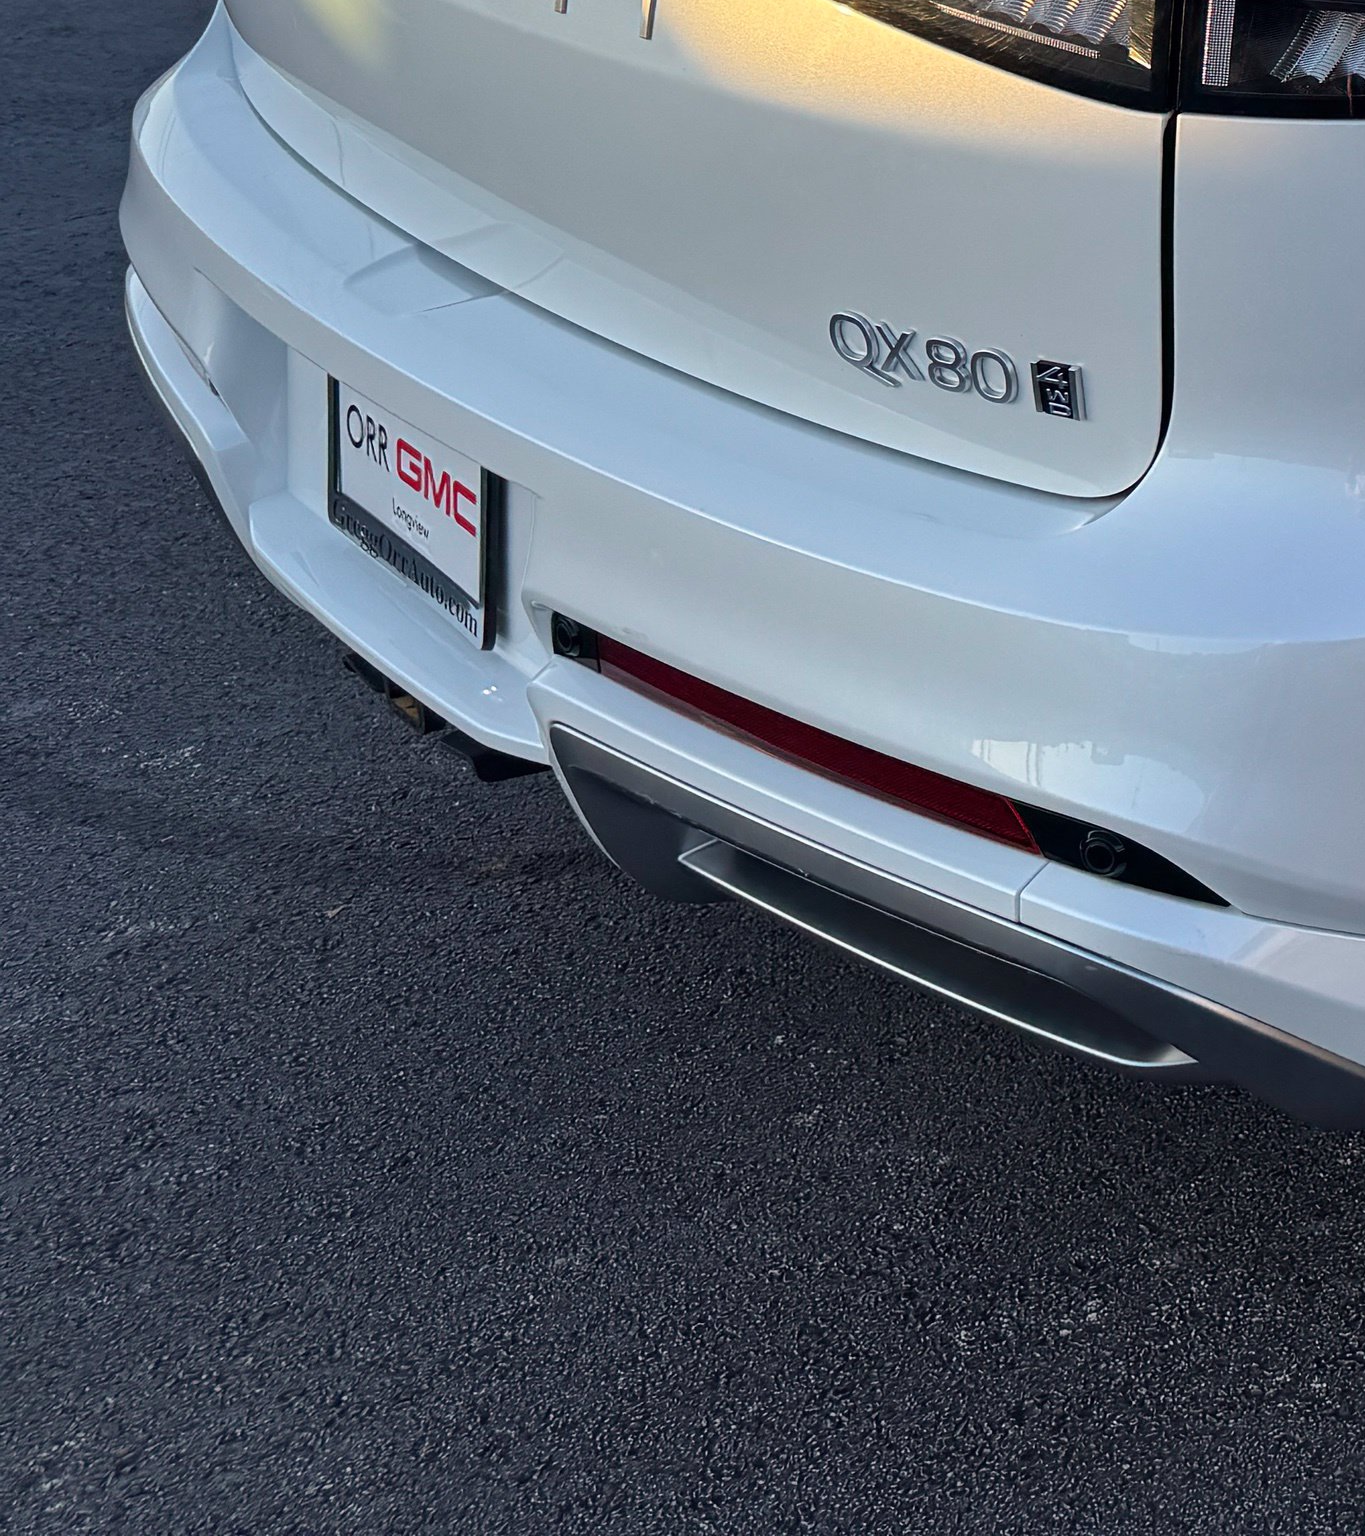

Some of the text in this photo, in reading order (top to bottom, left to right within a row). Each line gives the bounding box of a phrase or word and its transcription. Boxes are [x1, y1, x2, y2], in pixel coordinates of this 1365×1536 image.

[829, 310, 1020, 404] QX80
[346, 404, 478, 538] ORR GMC
